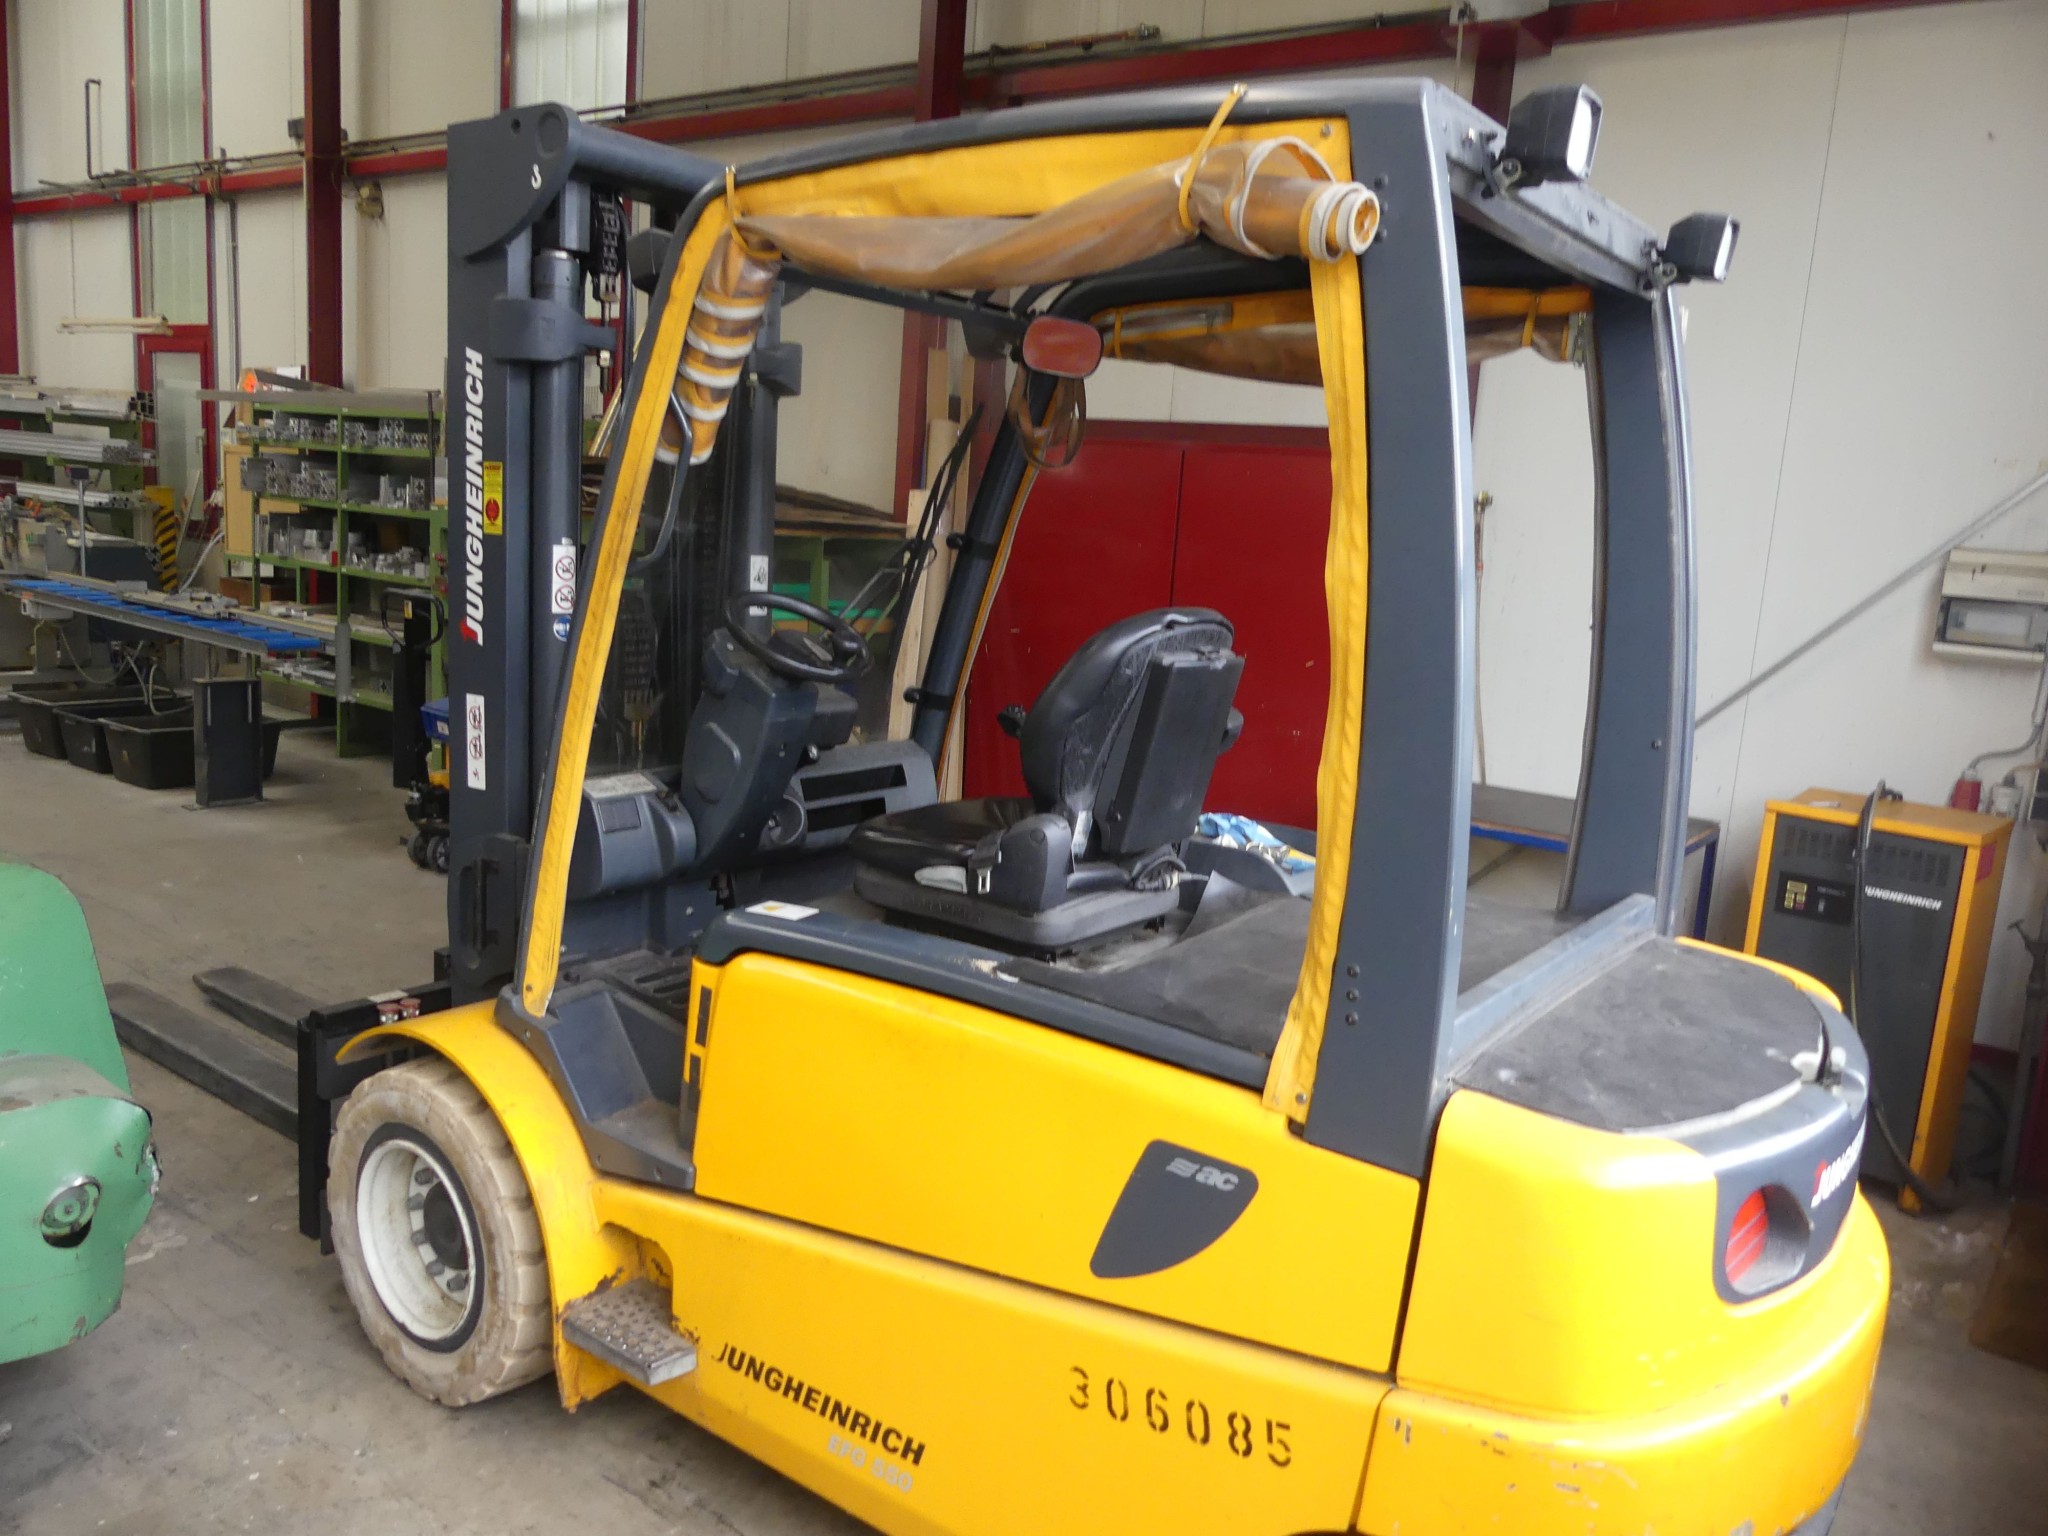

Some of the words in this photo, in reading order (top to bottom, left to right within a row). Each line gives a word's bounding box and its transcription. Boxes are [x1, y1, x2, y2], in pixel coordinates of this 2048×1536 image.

[460, 347, 483, 646] JUNGHEINRICH
[711, 1342, 925, 1466] JUNGHEINRICH
[827, 1434, 866, 1469] EFG
[1069, 1365, 1291, 1467] 306085
